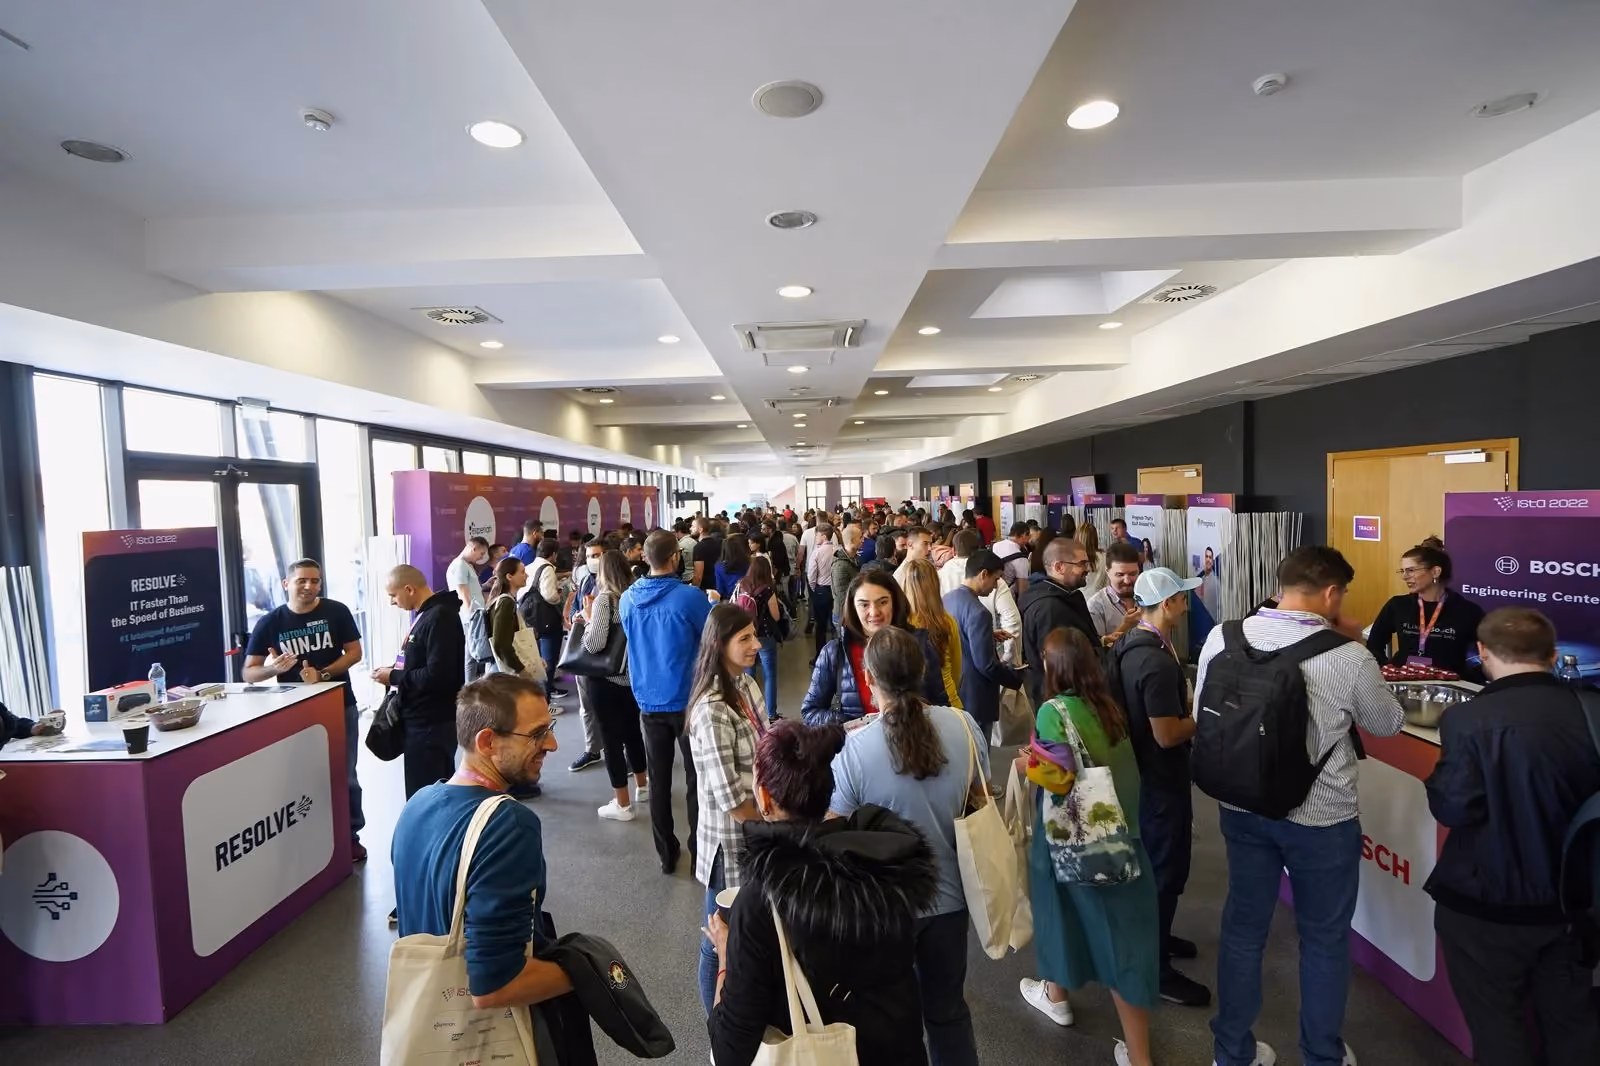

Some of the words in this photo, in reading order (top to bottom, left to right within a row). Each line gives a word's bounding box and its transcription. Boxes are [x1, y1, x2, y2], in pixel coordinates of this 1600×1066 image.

[1548, 498, 1589, 508] 2022
[155, 535, 177, 544] 2022
[1529, 560, 1600, 577] BOSCH
[131, 574, 177, 593] RESOLVE
[130, 601, 138, 612] IT
[140, 598, 168, 610] Faster
[168, 594, 189, 605] Than
[1462, 584, 1547, 602] Engineering
[1551, 591, 1600, 604] Cente
[111, 617, 127, 628] the
[129, 612, 158, 625] Speed
[169, 603, 205, 617] Business
[279, 631, 334, 656] NINJA
[215, 800, 299, 872] RESOLVE
